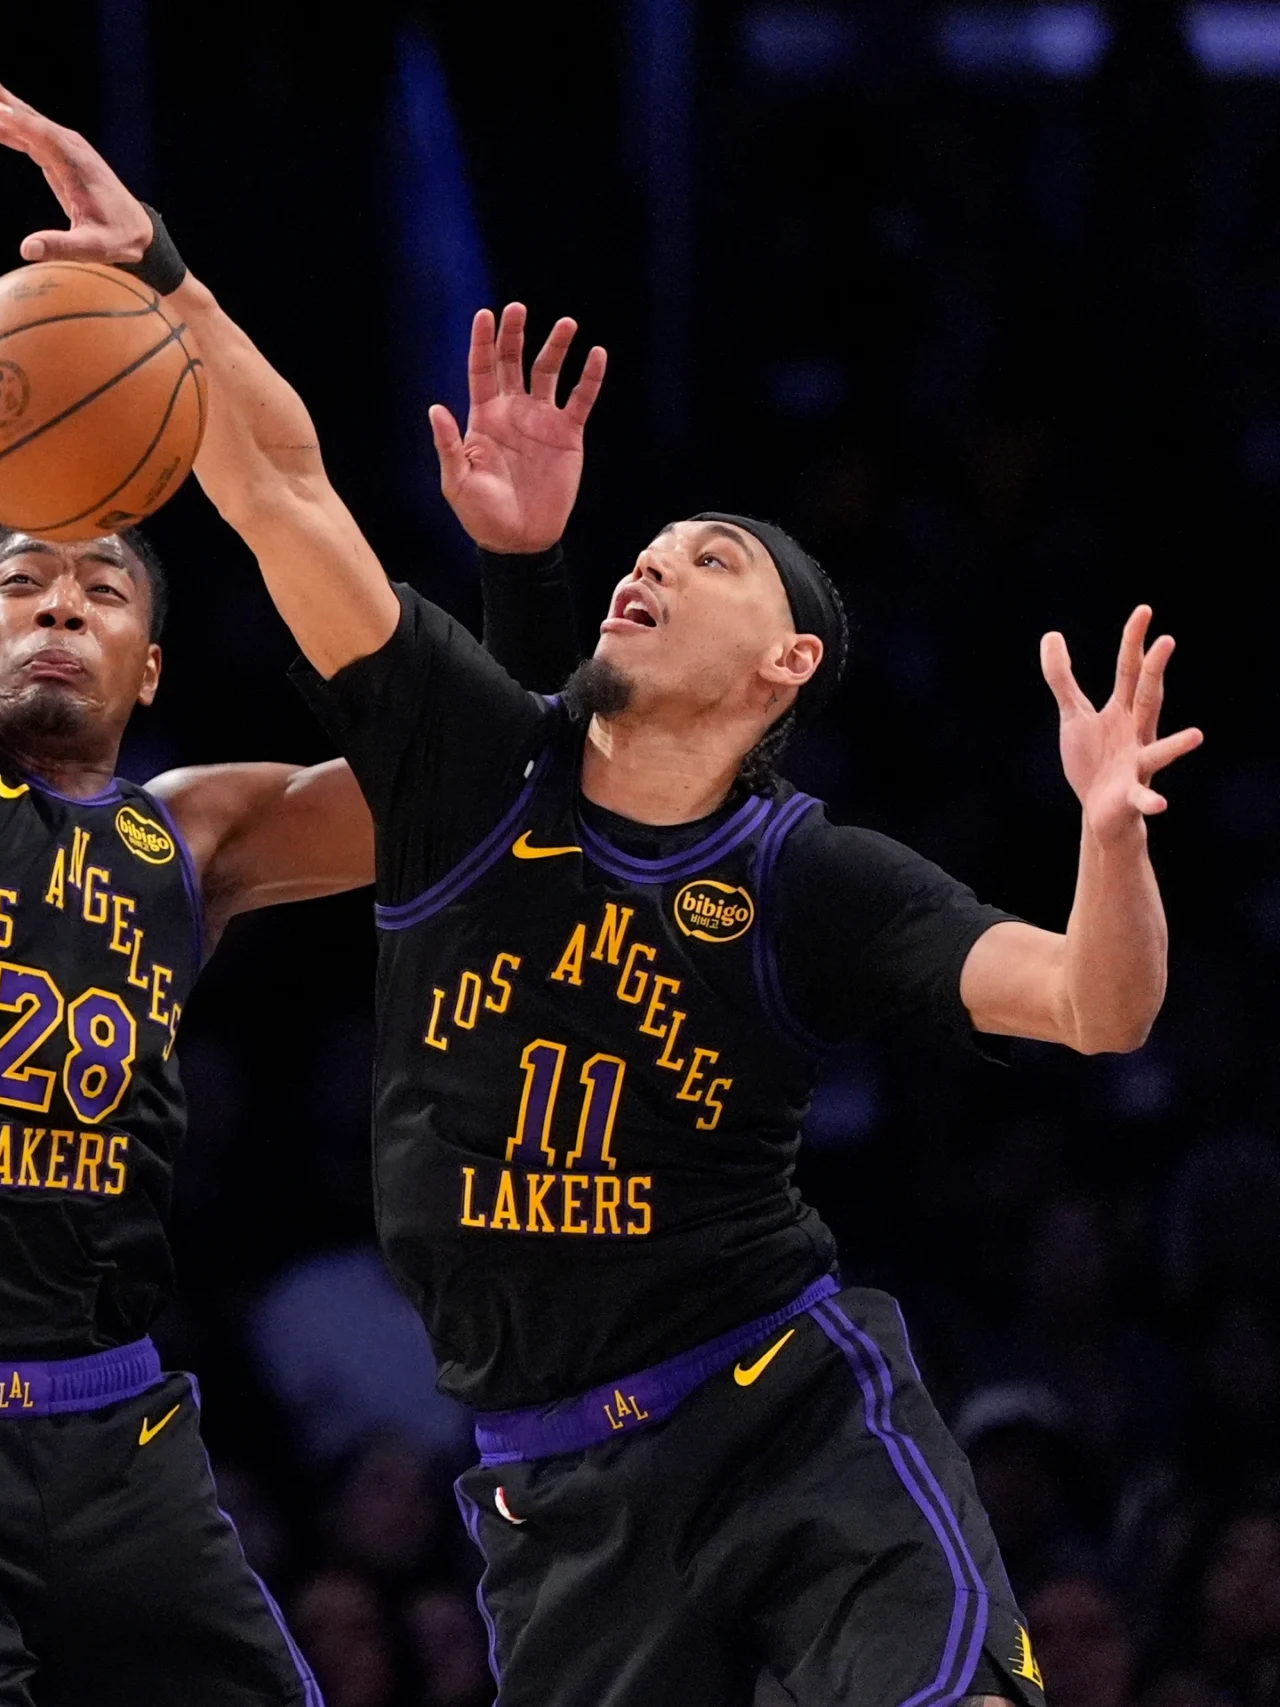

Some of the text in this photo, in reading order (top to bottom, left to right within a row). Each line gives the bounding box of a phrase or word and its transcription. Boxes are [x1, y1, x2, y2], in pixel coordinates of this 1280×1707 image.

[120, 815, 169, 852] bibigo
[682, 891, 749, 926] bibigo
[45, 826, 182, 1062] ANGELES
[424, 902, 733, 1131] LOS ANGELES
[505, 1038, 626, 1171] 11
[460, 1167, 653, 1235] LAKERS
[603, 1389, 649, 1430] LAL
